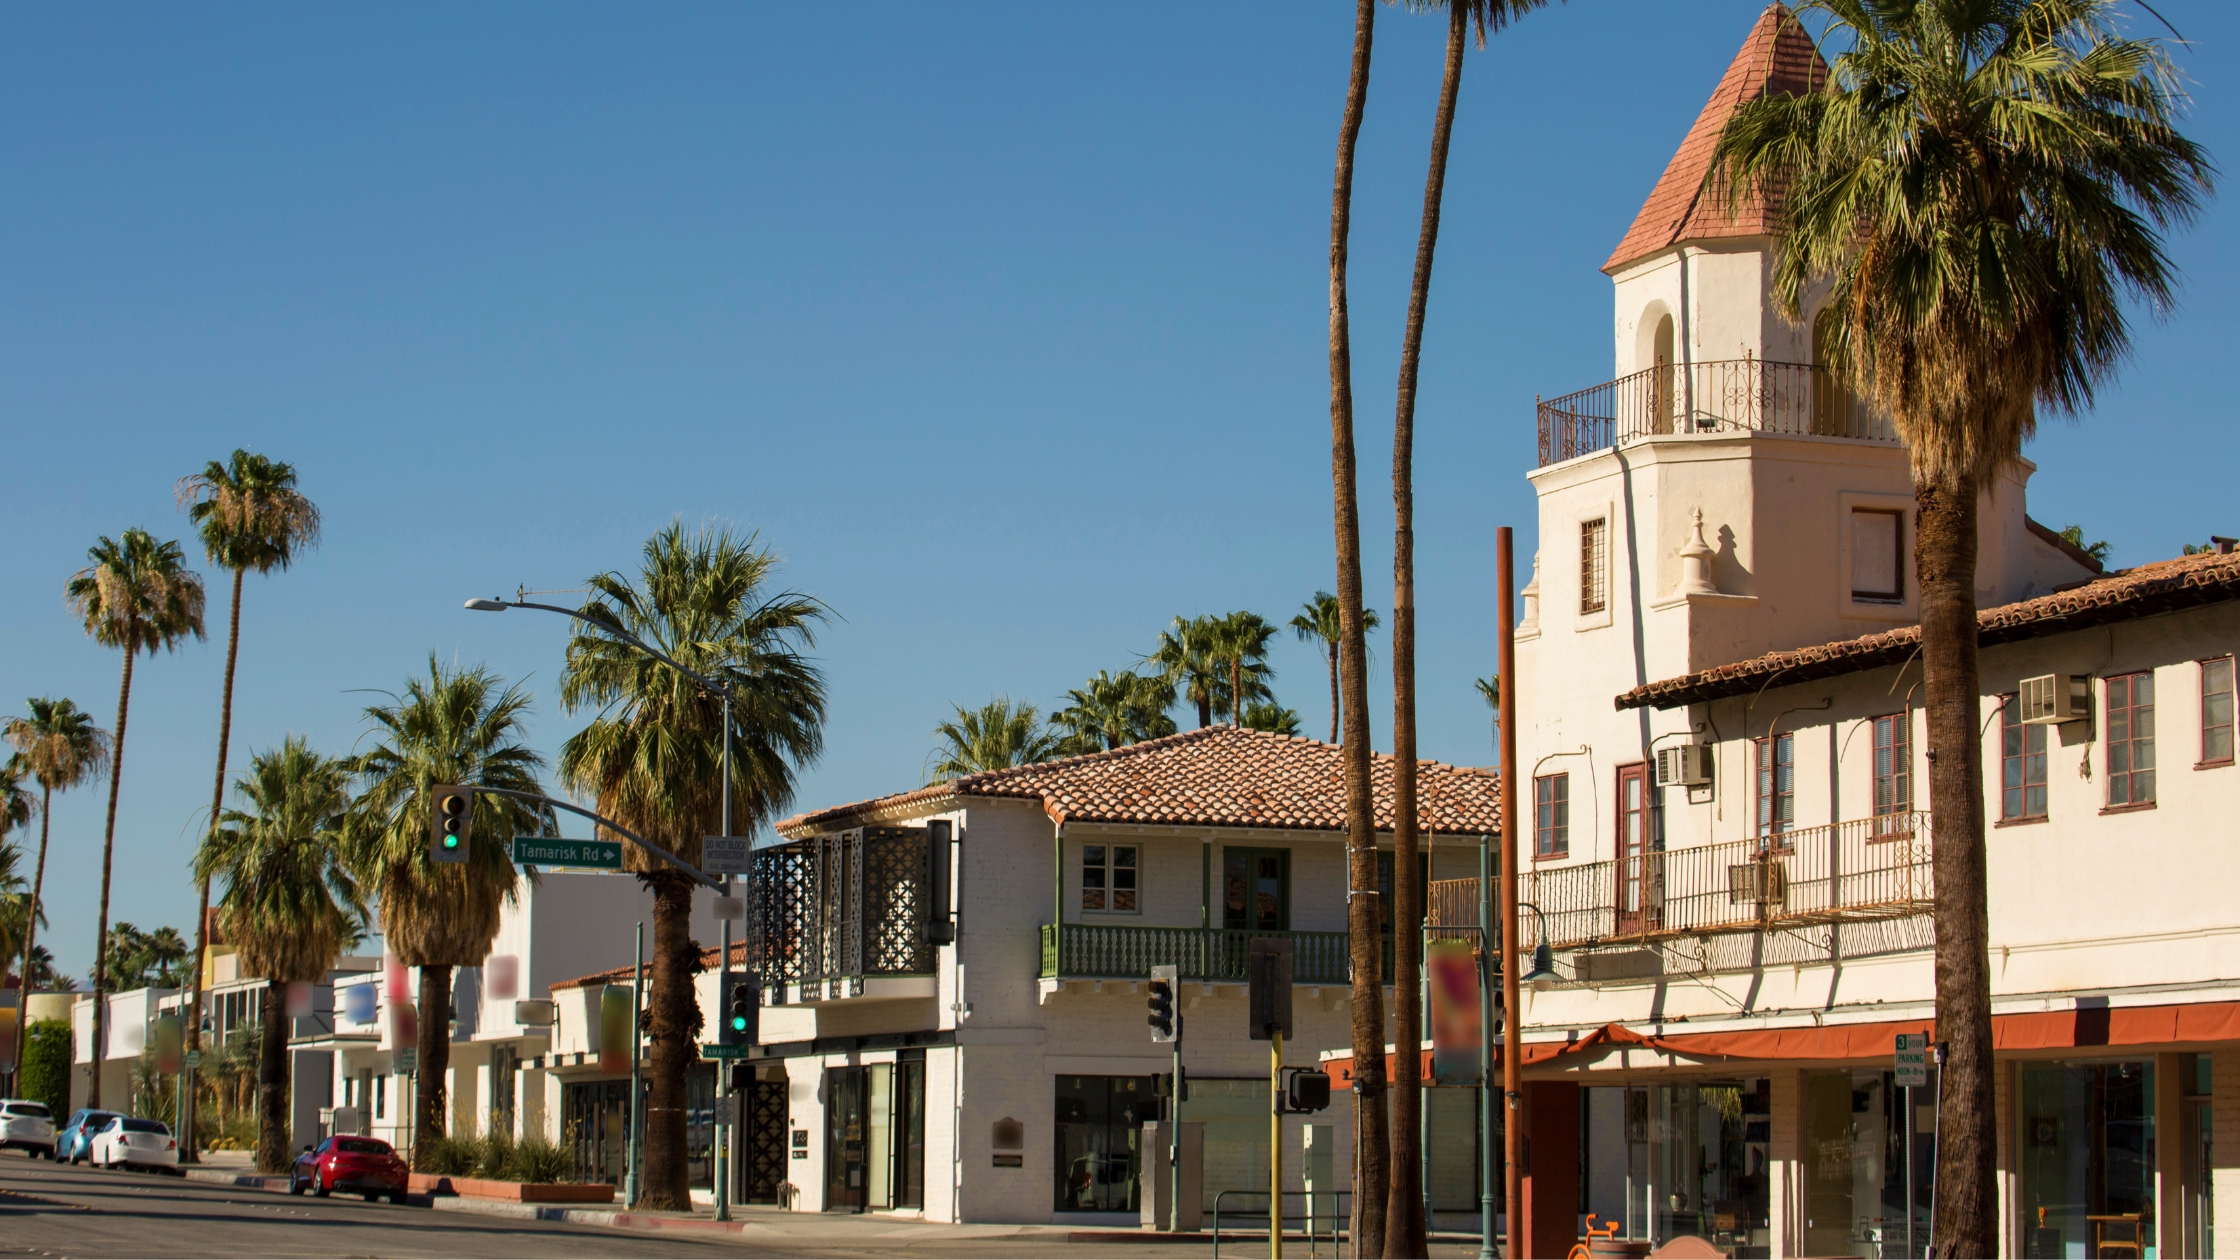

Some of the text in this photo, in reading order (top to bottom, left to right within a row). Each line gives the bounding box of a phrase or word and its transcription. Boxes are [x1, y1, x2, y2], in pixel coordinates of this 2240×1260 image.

[705, 840, 746, 850] DO NOT BLOCK
[520, 843, 599, 861] Tamarisk Rd
[707, 850, 745, 860] INTERSECTION
[1898, 1036, 1923, 1048] 3 HOUR
[704, 1048, 739, 1057] TAMARISK
[1898, 1053, 1924, 1064] PARKING
